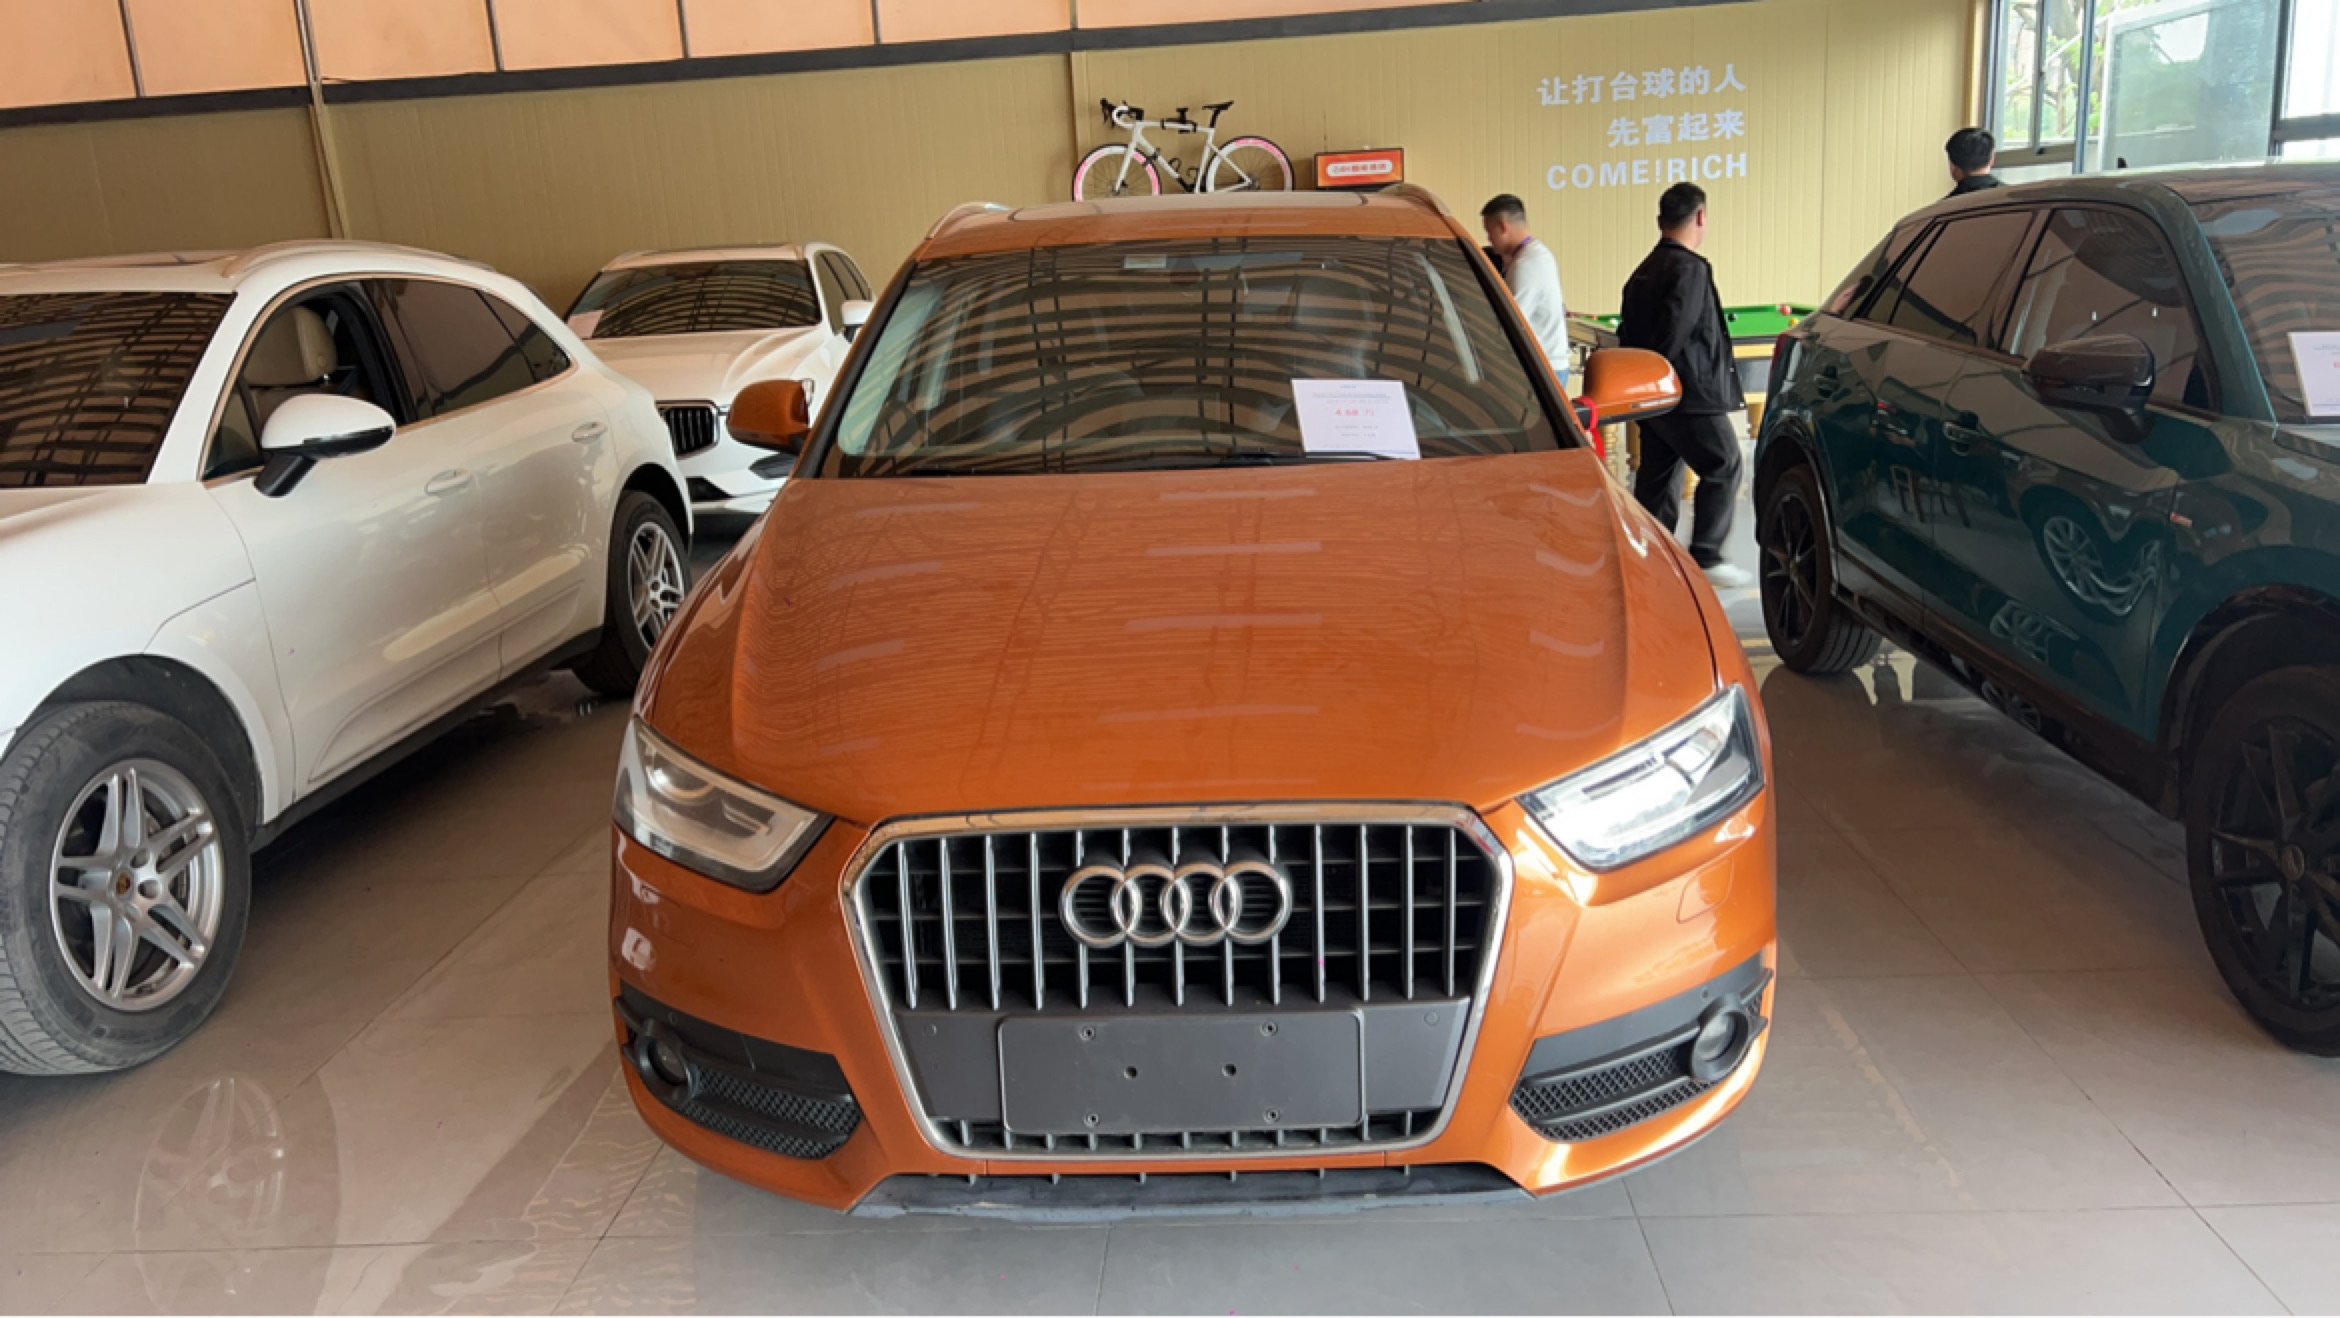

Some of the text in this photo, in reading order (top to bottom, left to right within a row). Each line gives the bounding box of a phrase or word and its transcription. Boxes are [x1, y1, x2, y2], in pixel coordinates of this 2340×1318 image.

[1537, 63, 1746, 106] 让打台球的人
[1608, 109, 1745, 148] 先富起来
[1547, 152, 1747, 190] COME!RICH
